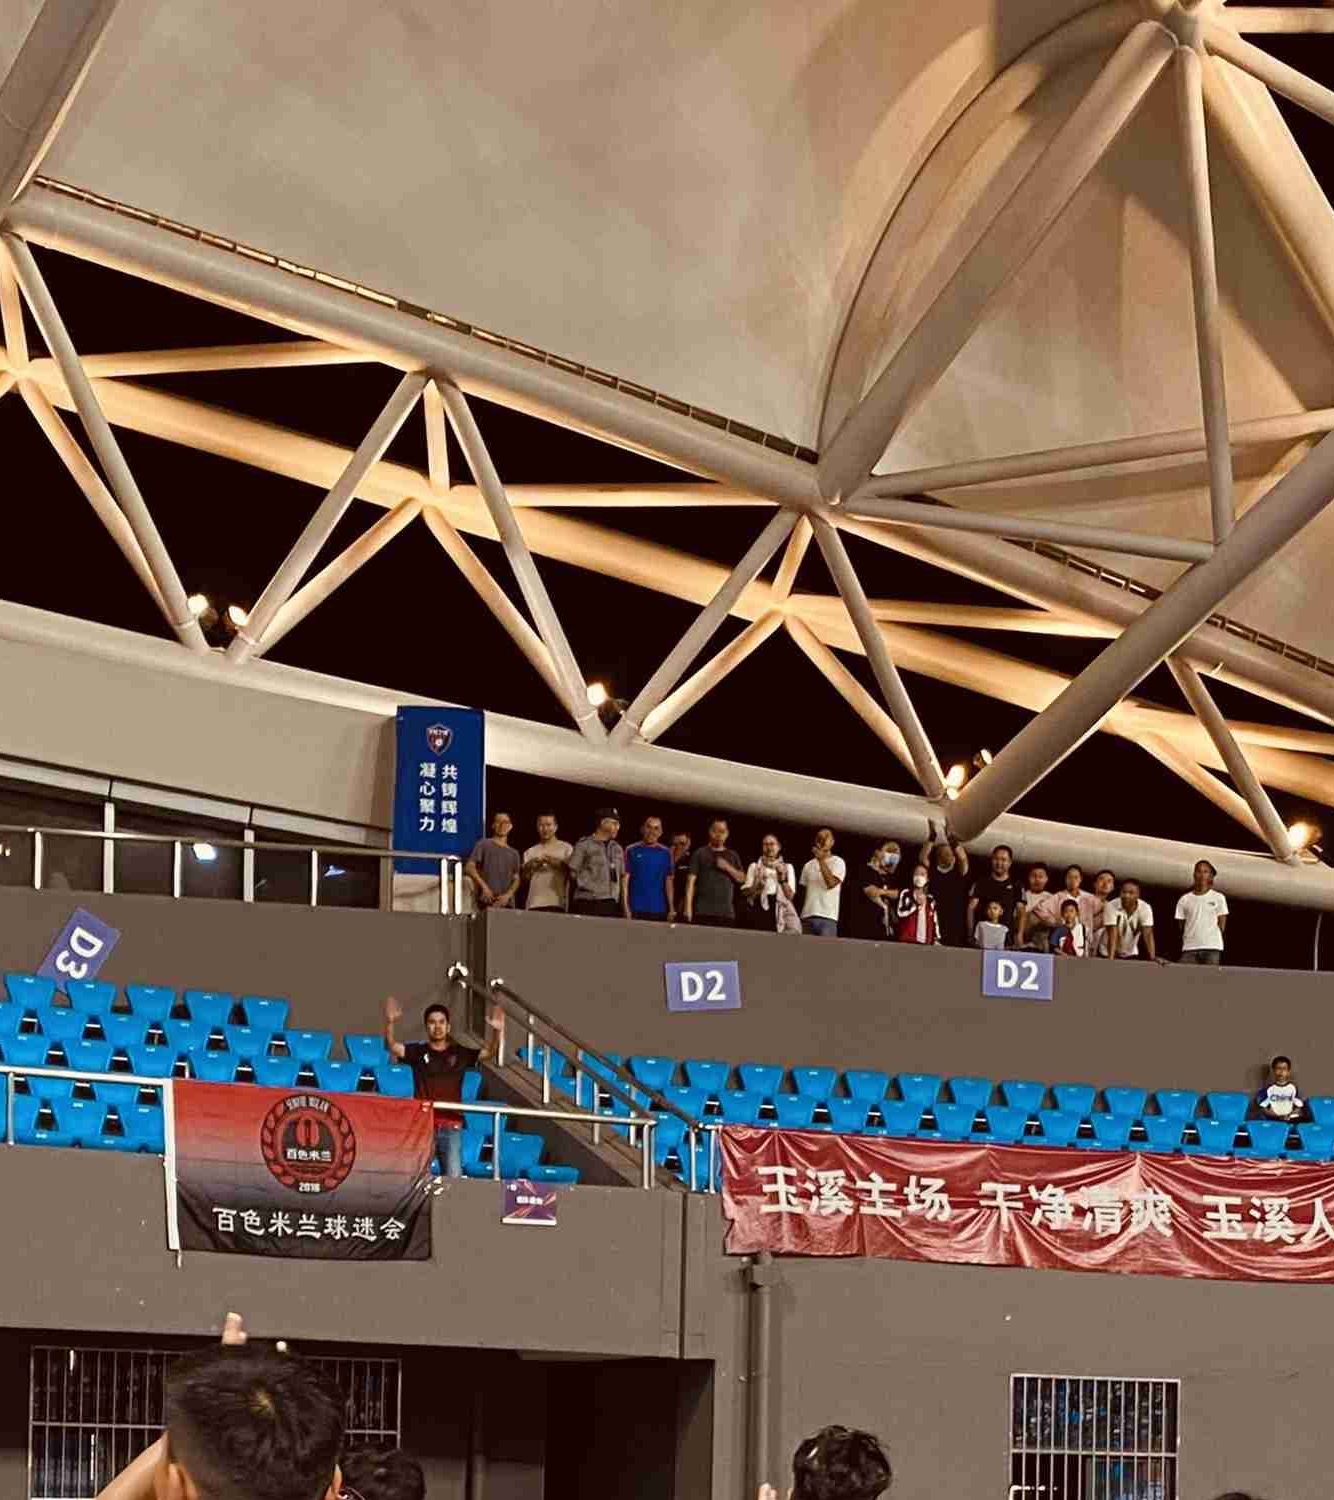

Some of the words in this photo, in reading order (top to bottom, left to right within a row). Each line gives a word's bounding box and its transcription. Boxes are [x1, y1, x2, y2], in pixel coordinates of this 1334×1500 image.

[419, 762, 436, 832] 凝心聚力
[55, 926, 104, 979] D3
[680, 970, 726, 1002] D2
[997, 960, 1040, 991] D2
[757, 1165, 952, 1223] 玉溪主场
[978, 1181, 1174, 1238] 干净清爽
[212, 1207, 406, 1242] 百色米兰球迷会
